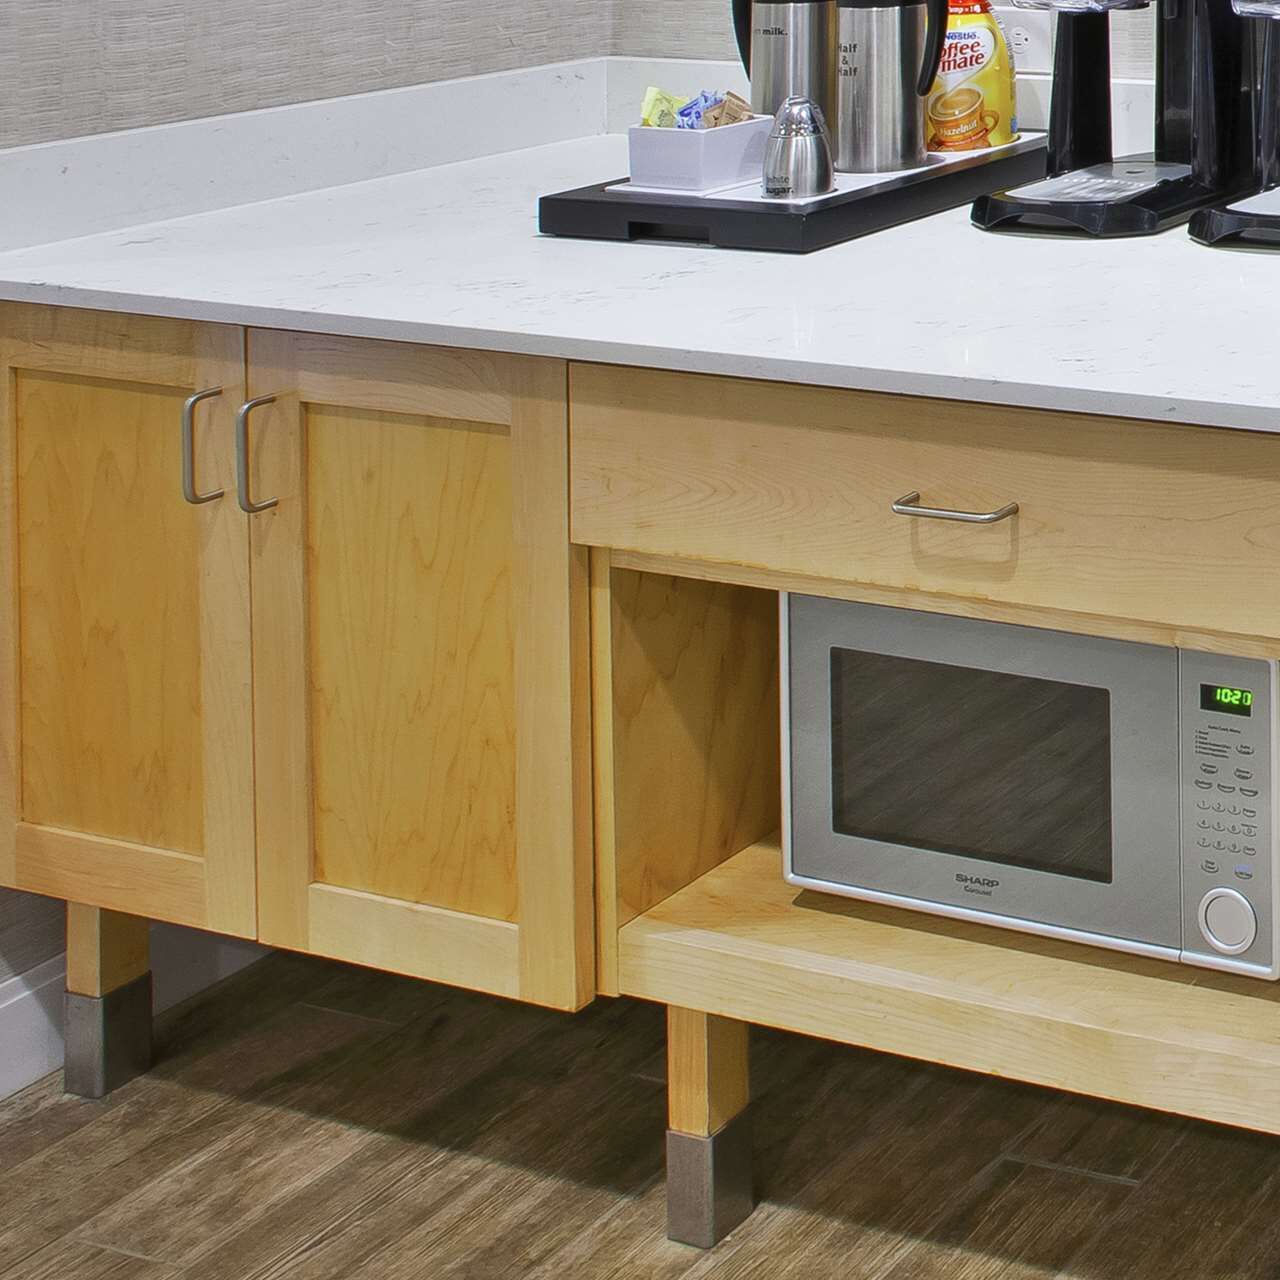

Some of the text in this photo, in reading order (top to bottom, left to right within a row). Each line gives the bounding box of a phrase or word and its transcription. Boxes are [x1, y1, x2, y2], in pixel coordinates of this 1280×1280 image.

[762, 27, 788, 36] milk.
[842, 55, 849, 65] &
[941, 53, 985, 72] mate
[955, 873, 999, 888] SHARP
